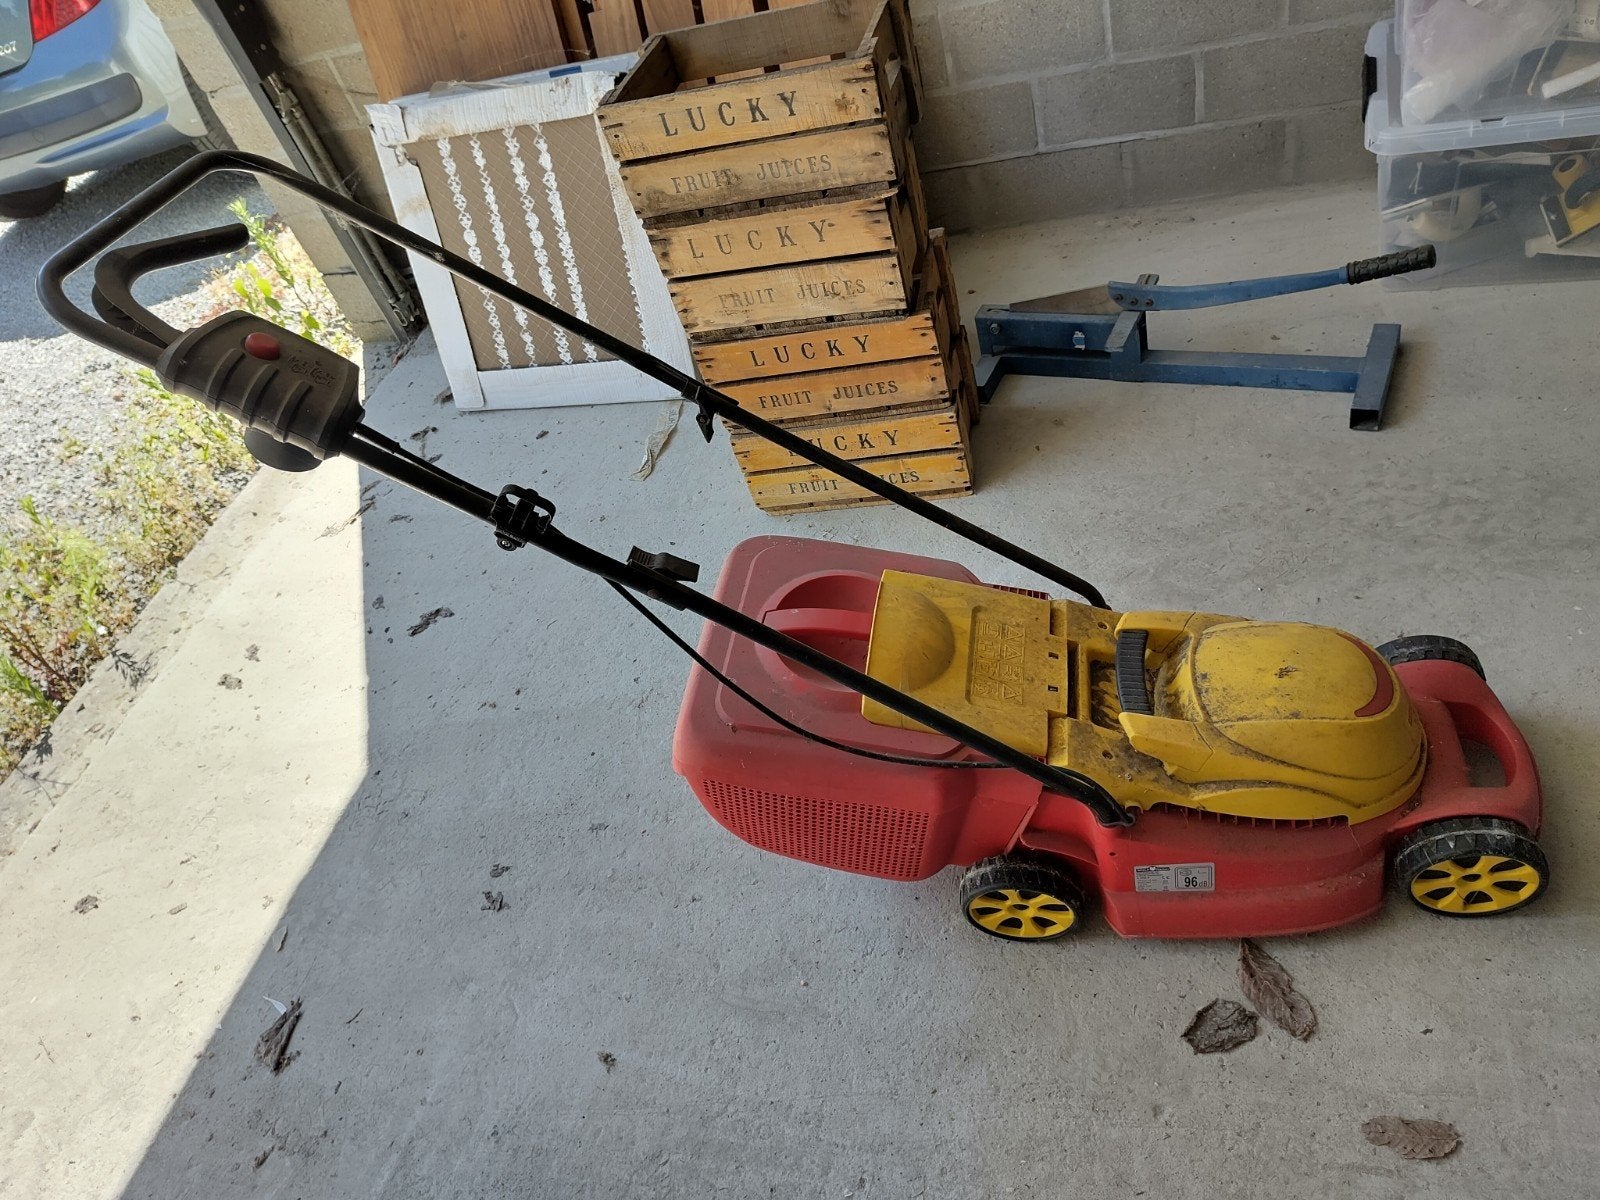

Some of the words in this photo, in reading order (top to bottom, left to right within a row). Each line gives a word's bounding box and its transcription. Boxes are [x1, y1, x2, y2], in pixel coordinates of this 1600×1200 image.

[658, 91, 797, 137] LUCKY
[670, 168, 735, 194] FRUIT
[756, 154, 832, 181] JUICES
[687, 219, 827, 260] LUCKY
[717, 288, 776, 309] FRUIT
[797, 278, 866, 301] JUICES
[749, 335, 869, 367] LUCKY
[758, 390, 812, 409] FRUIT
[832, 380, 899, 400] JUICES
[789, 429, 899, 457] CKY
[788, 478, 838, 495] FRUIT
[1184, 876, 1198, 888] 96
